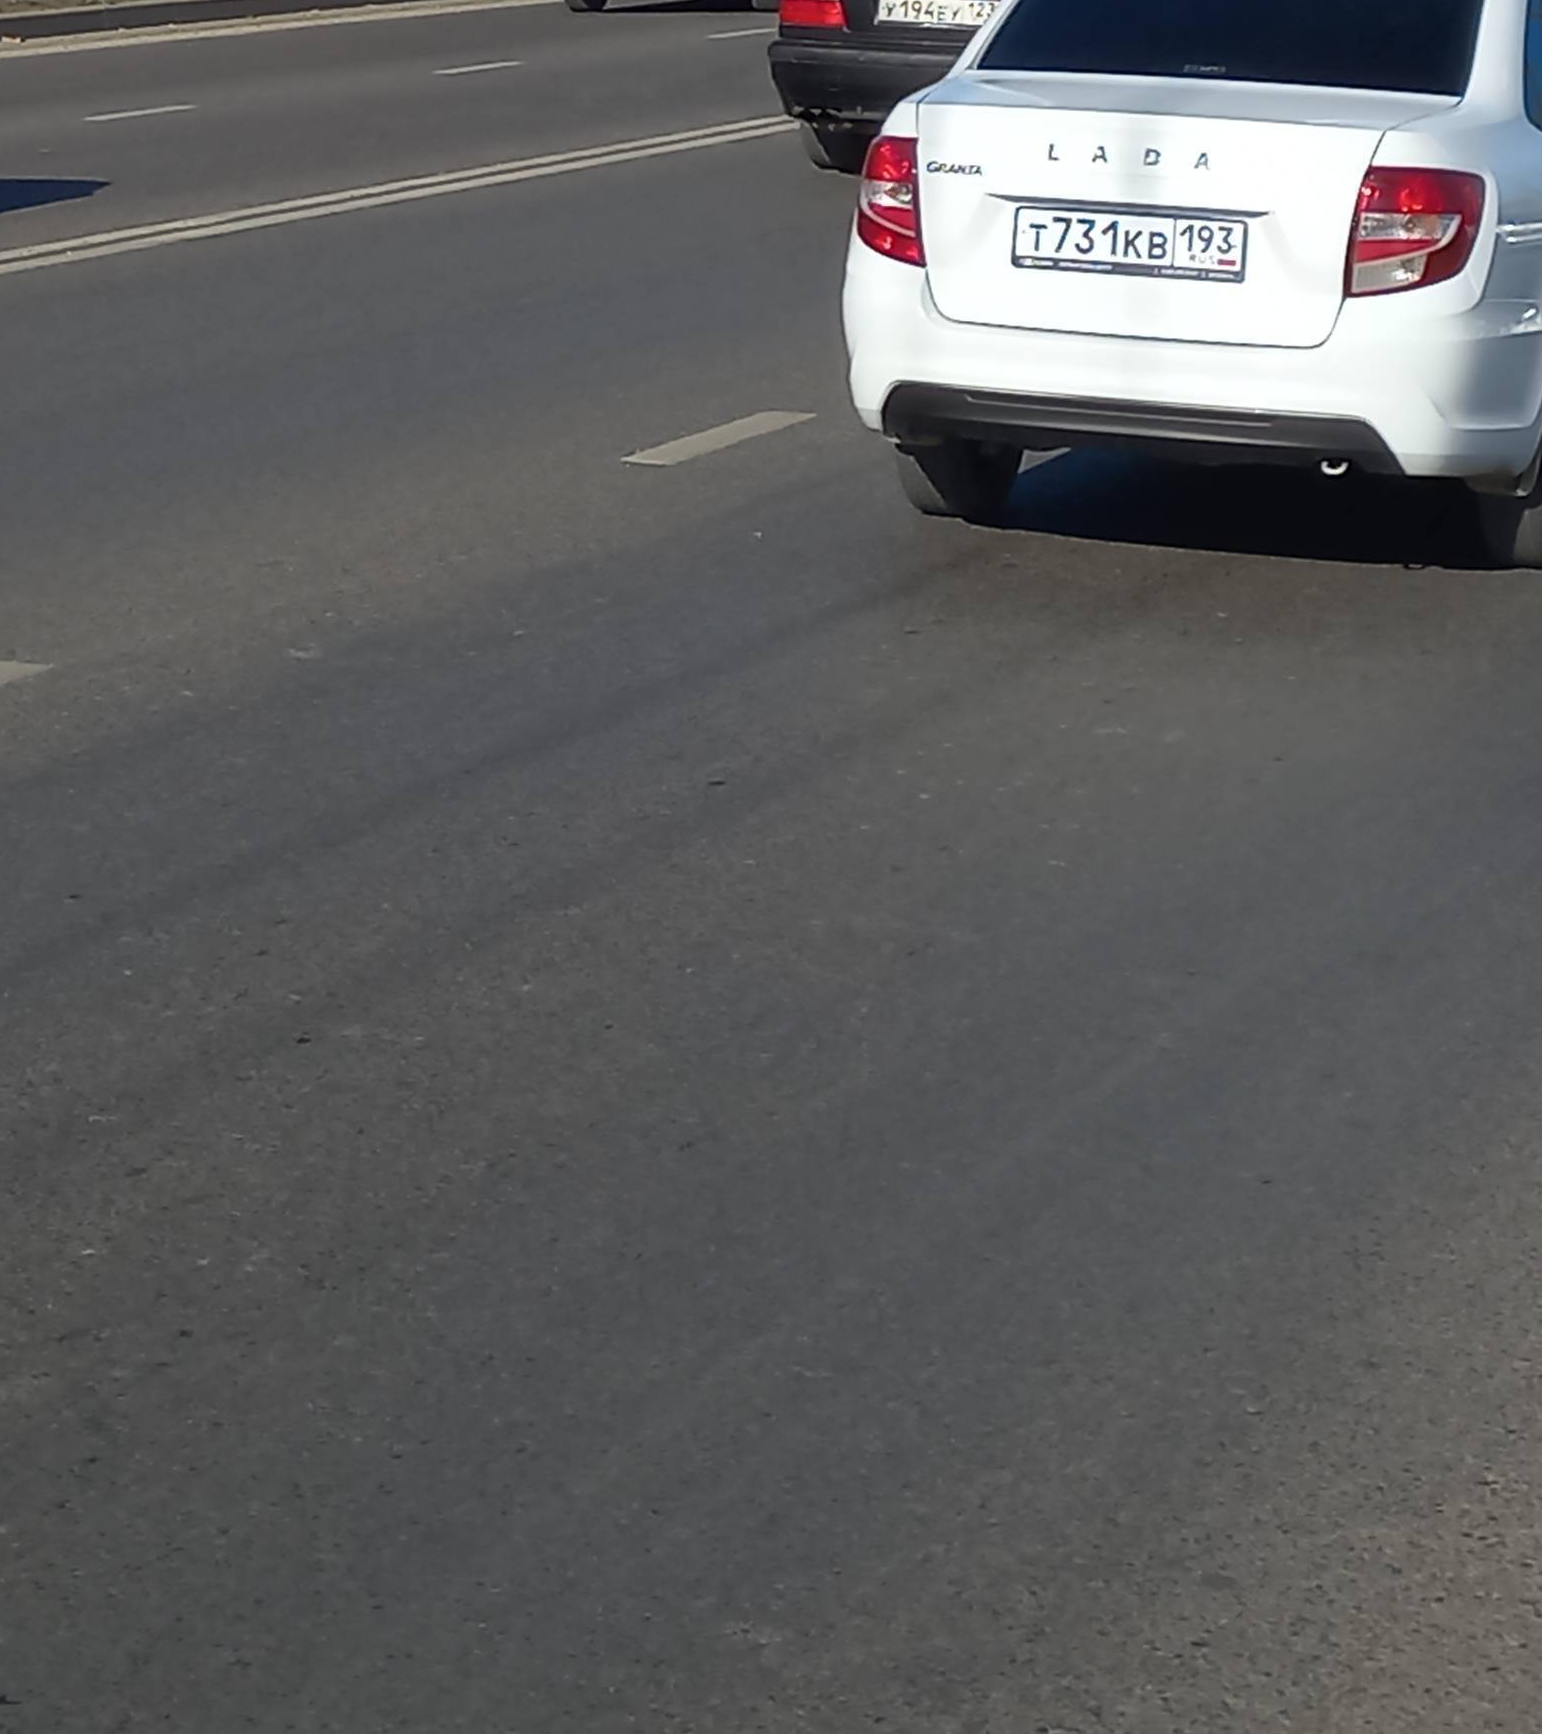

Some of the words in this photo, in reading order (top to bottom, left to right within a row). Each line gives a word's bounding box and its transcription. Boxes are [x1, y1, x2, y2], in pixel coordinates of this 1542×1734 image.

[1047, 143, 1212, 172] LADA
[1028, 215, 1170, 261] Т731КВ
[1178, 222, 1235, 256] 193
